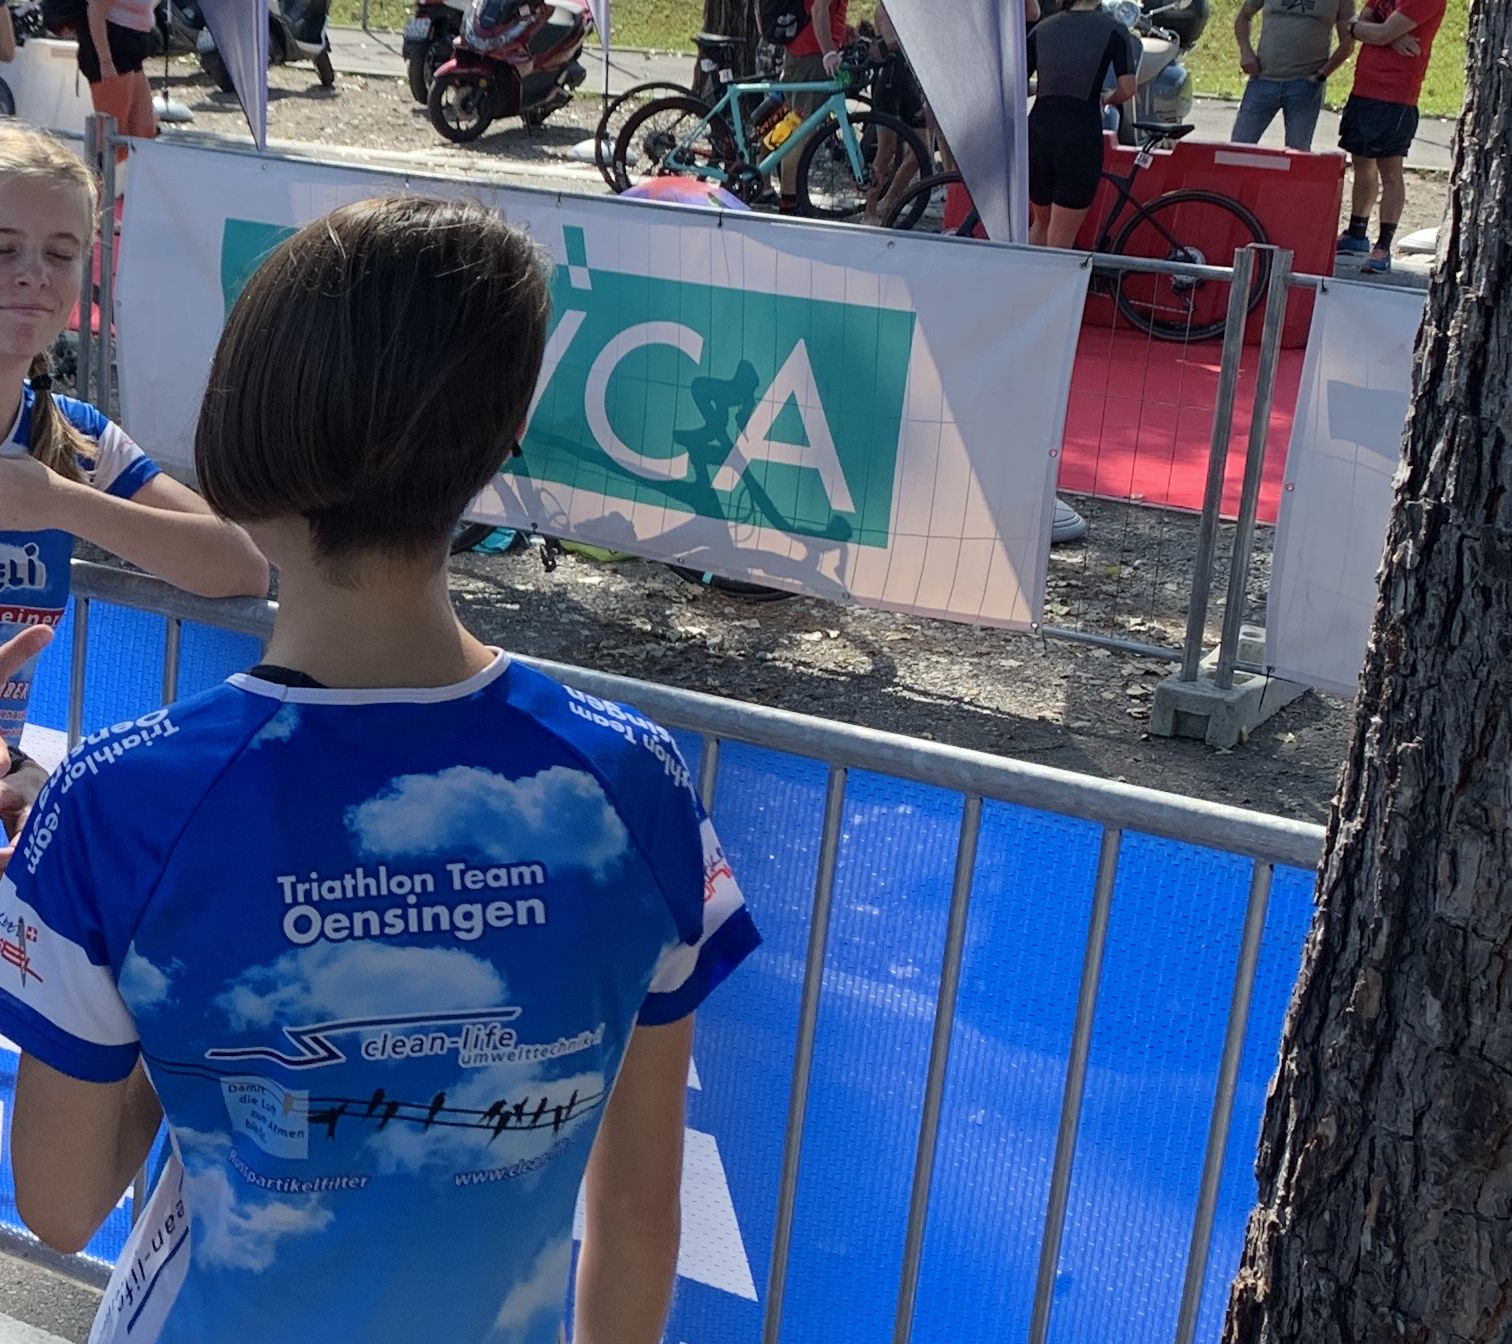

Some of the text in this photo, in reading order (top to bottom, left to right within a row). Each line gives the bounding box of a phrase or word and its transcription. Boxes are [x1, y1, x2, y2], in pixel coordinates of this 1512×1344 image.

[277, 862, 545, 905] Triathlon Team
[282, 893, 547, 945] Oensingen
[363, 1023, 515, 1058] clean-life
